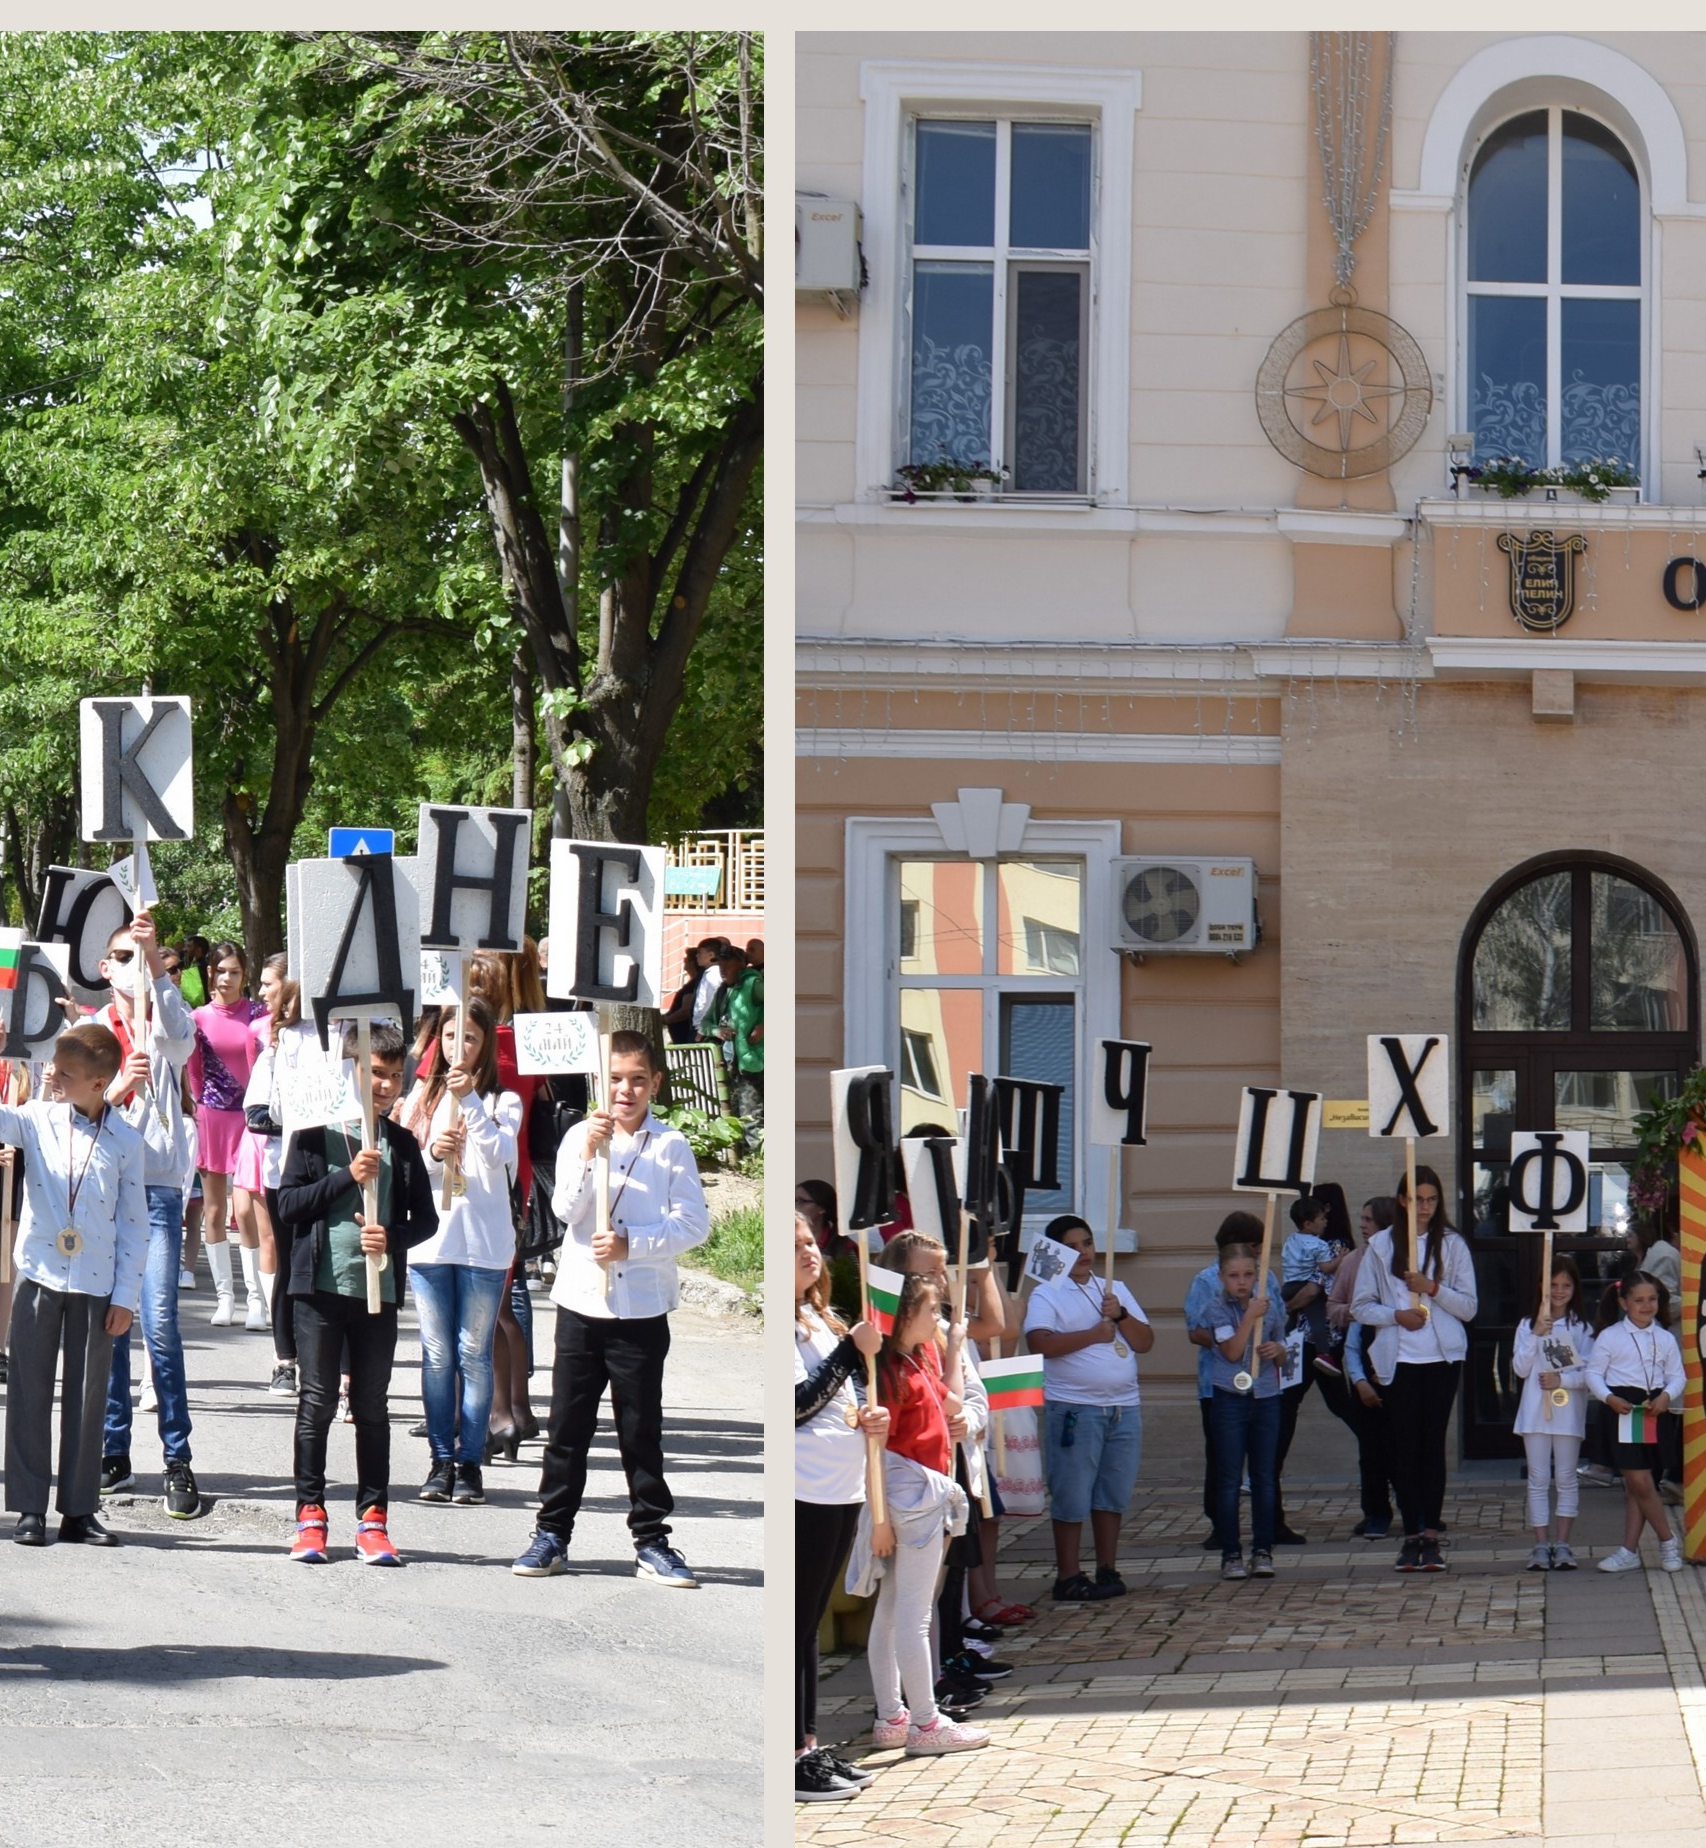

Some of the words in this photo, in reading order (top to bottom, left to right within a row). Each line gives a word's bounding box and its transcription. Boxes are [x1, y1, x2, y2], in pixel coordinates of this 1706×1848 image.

[93, 700, 186, 842] К
[421, 808, 529, 952] Н
[570, 845, 641, 1000] Е
[311, 854, 417, 1052] Д
[848, 1070, 895, 1232] Я
[1101, 1040, 1152, 1146] Ч
[1236, 1088, 1318, 1198] Ц
[1380, 1036, 1439, 1136] Х
[1511, 1132, 1584, 1232] Ф
